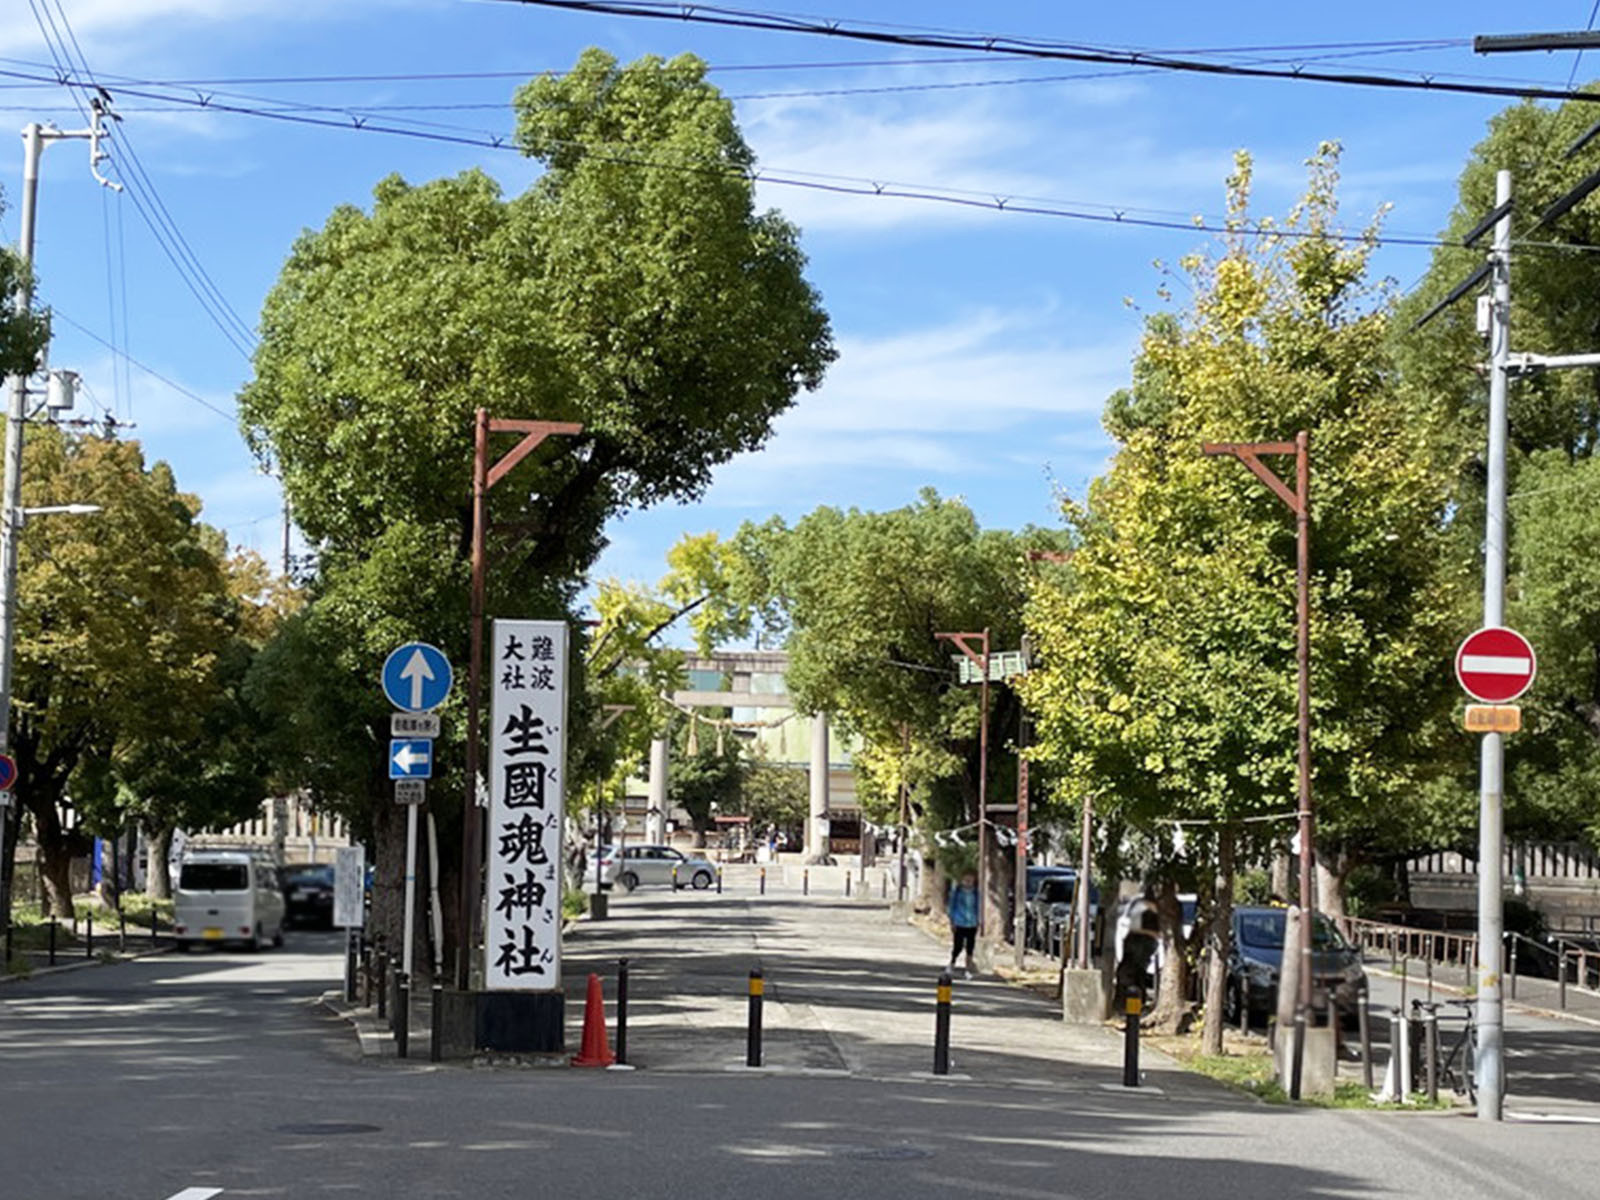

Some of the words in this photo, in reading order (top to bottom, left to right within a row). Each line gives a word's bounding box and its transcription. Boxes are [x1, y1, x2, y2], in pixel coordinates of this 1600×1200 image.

[501, 634, 527, 691] 大社
[530, 635, 556, 691] 難波
[494, 704, 549, 977] 生國魂神社
[540, 725, 559, 964] いくたまさん
